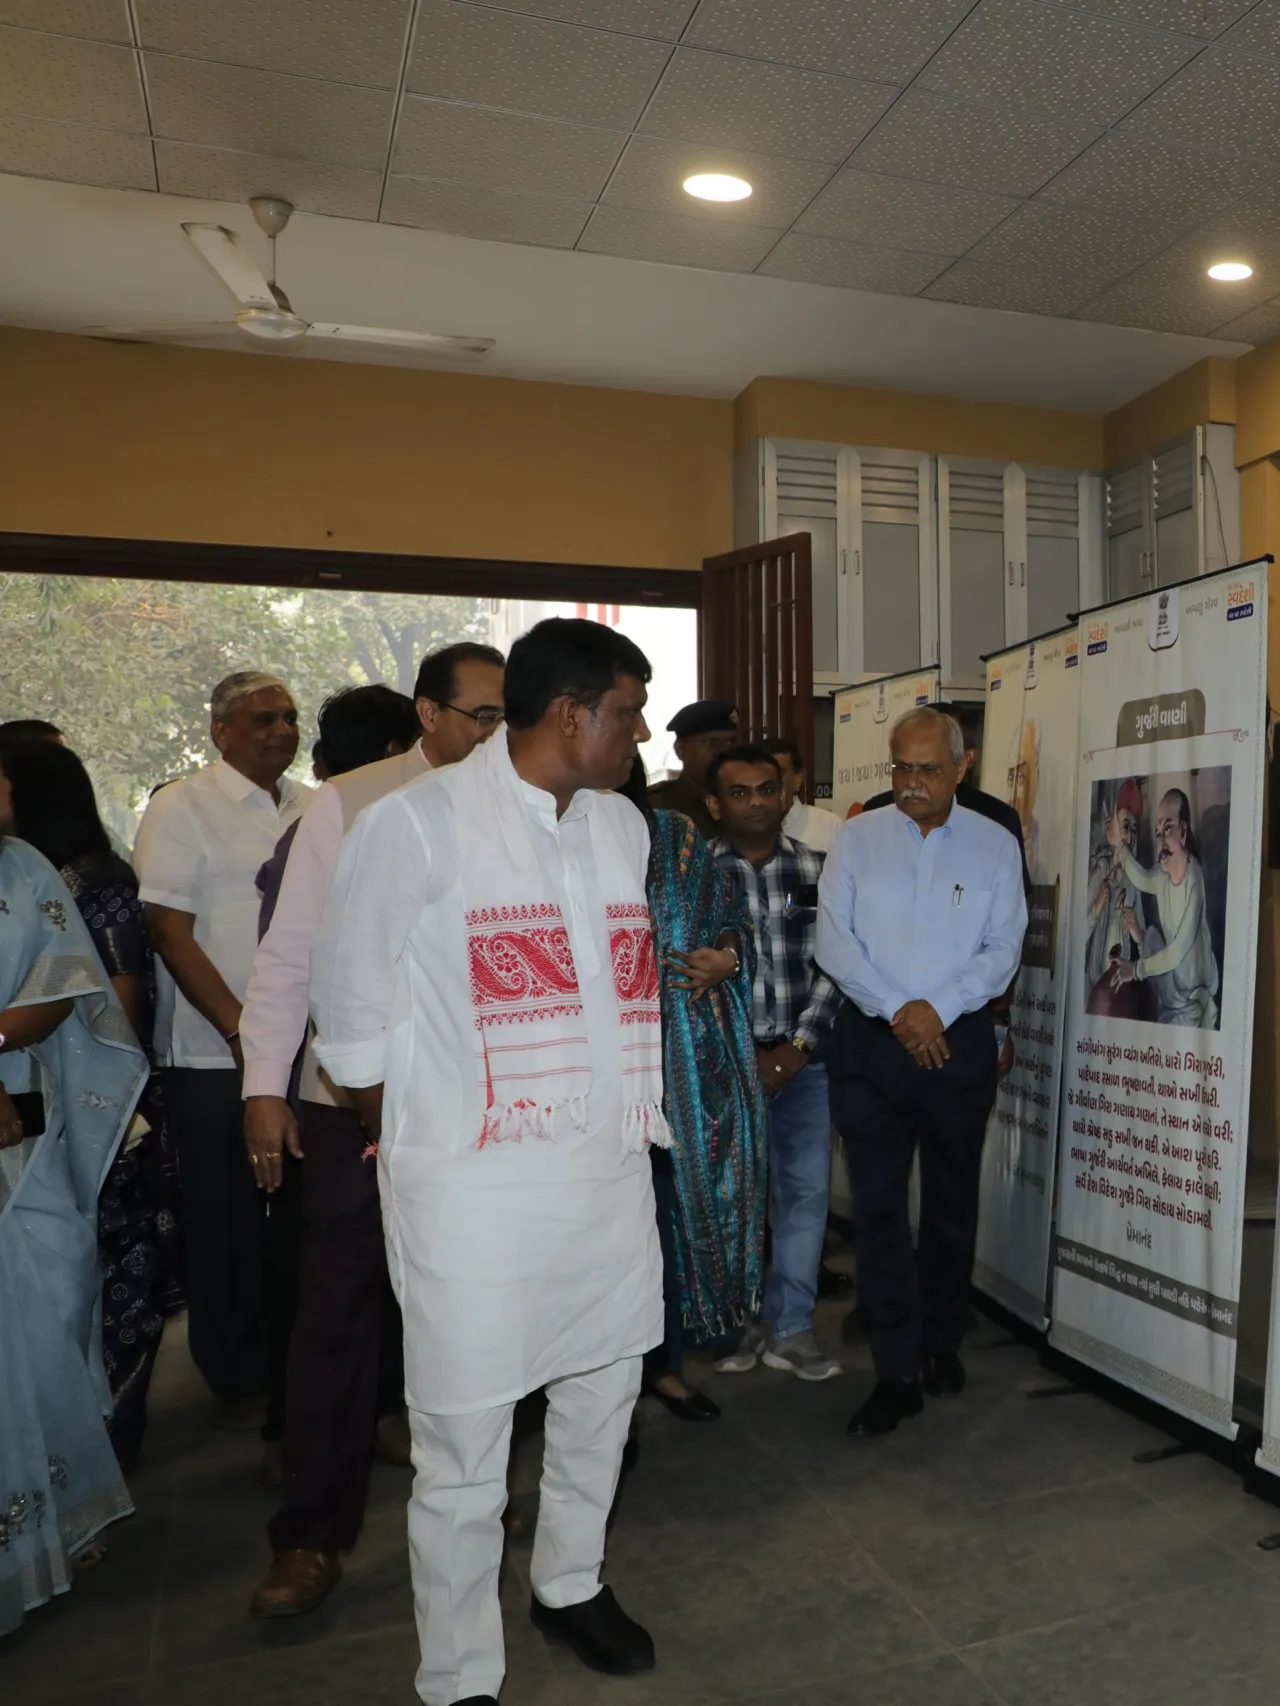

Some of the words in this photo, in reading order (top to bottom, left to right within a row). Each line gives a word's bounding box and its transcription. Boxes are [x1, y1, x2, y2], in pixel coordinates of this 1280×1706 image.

[1160, 701, 1187, 726] વાણી
[1102, 1072, 1120, 1088] રસાળ
[1179, 1083, 1201, 1103] સખી
[1168, 1114, 1189, 1131] સ્થાન
[1192, 1114, 1201, 1133] એ
[1162, 1166, 1183, 1191] ફેલાય
